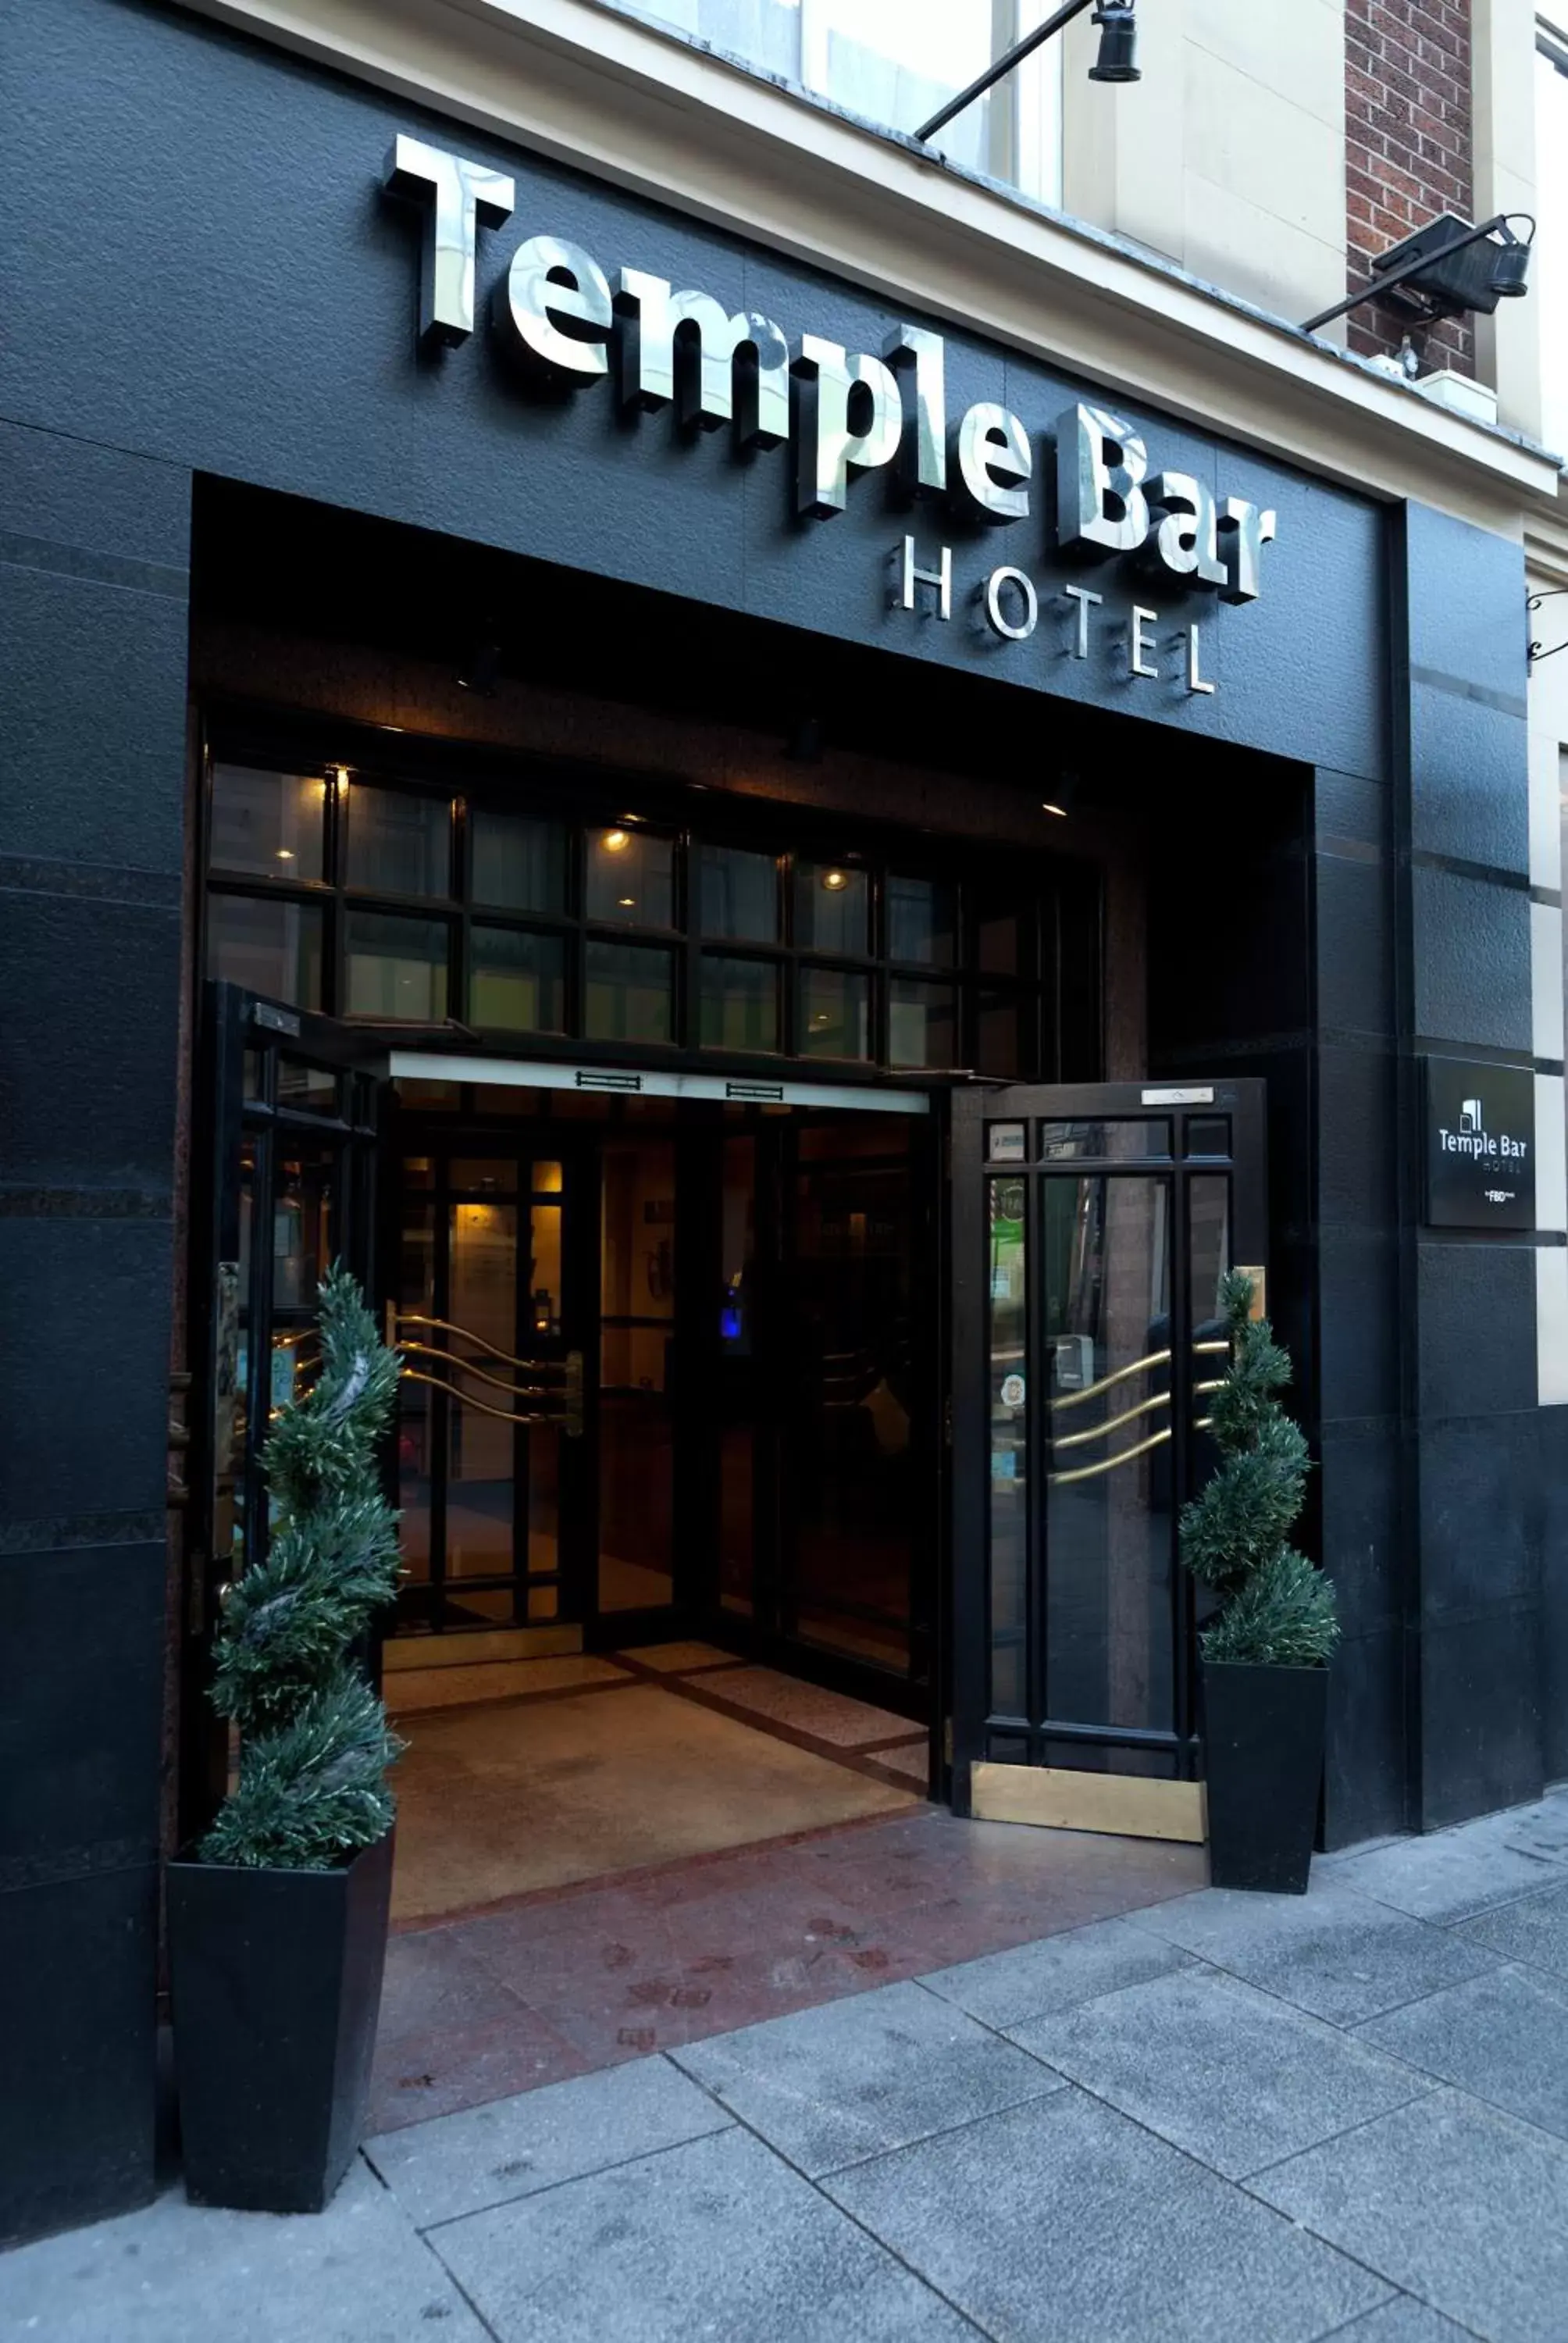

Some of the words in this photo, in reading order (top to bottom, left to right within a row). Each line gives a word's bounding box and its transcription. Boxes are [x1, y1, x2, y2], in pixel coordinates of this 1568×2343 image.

[392, 133, 1032, 523] Temple
[1060, 403, 1277, 604] Bar
[901, 536, 1215, 694] HOTEL
[1439, 1129, 1497, 1160] Temple
[1500, 1135, 1527, 1158] Bar
